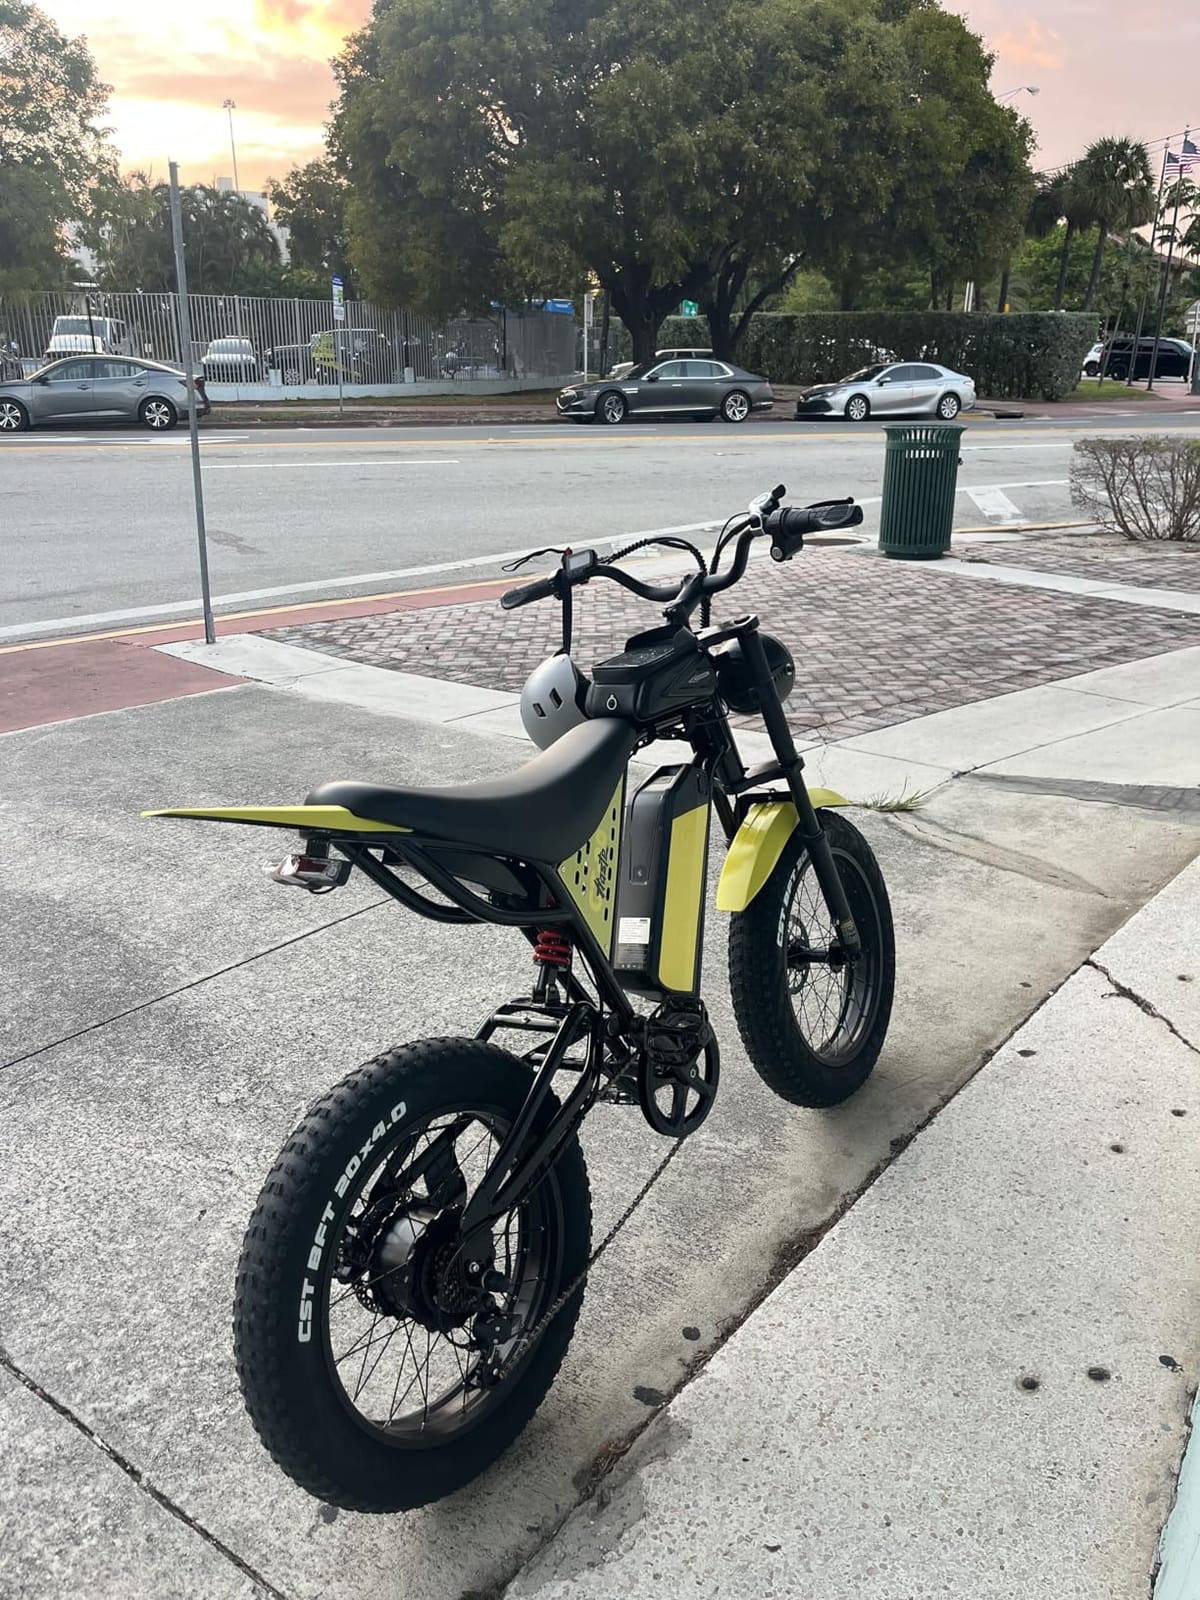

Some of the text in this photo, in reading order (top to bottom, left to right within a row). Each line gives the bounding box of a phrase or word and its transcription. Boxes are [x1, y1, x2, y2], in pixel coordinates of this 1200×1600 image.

[777, 908, 785, 948] CST
[298, 1278, 315, 1342] CST
[307, 1200, 335, 1271] BFT
